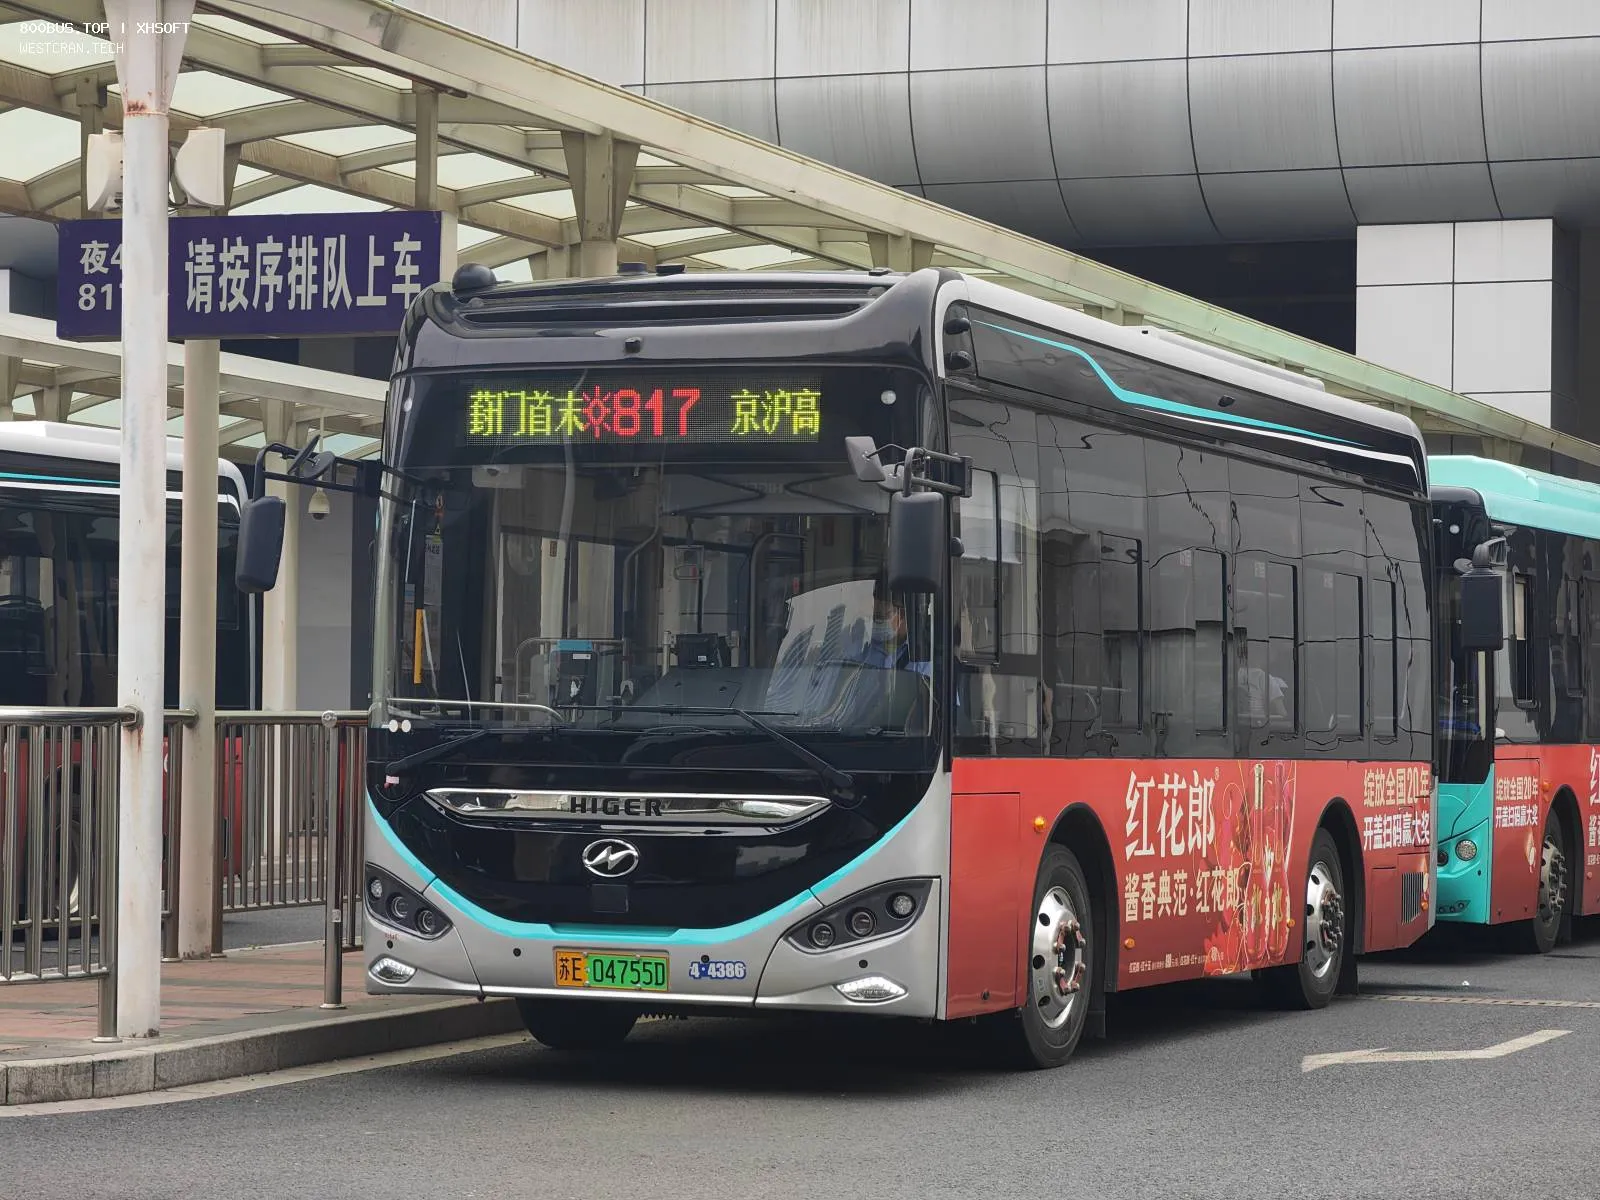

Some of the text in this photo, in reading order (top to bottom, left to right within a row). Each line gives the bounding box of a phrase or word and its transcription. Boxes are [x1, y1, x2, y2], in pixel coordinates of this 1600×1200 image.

[184, 232, 423, 315] 请按序排队上车
[78, 283, 123, 311] 81
[613, 388, 702, 436] 817
[730, 388, 822, 435] 京沪高
[570, 796, 663, 817] HIGER
[1125, 770, 1215, 862] 红花郎
[1363, 810, 1430, 851] 开盖扫码赢大奖
[559, 957, 666, 987] 苏E 04755D
